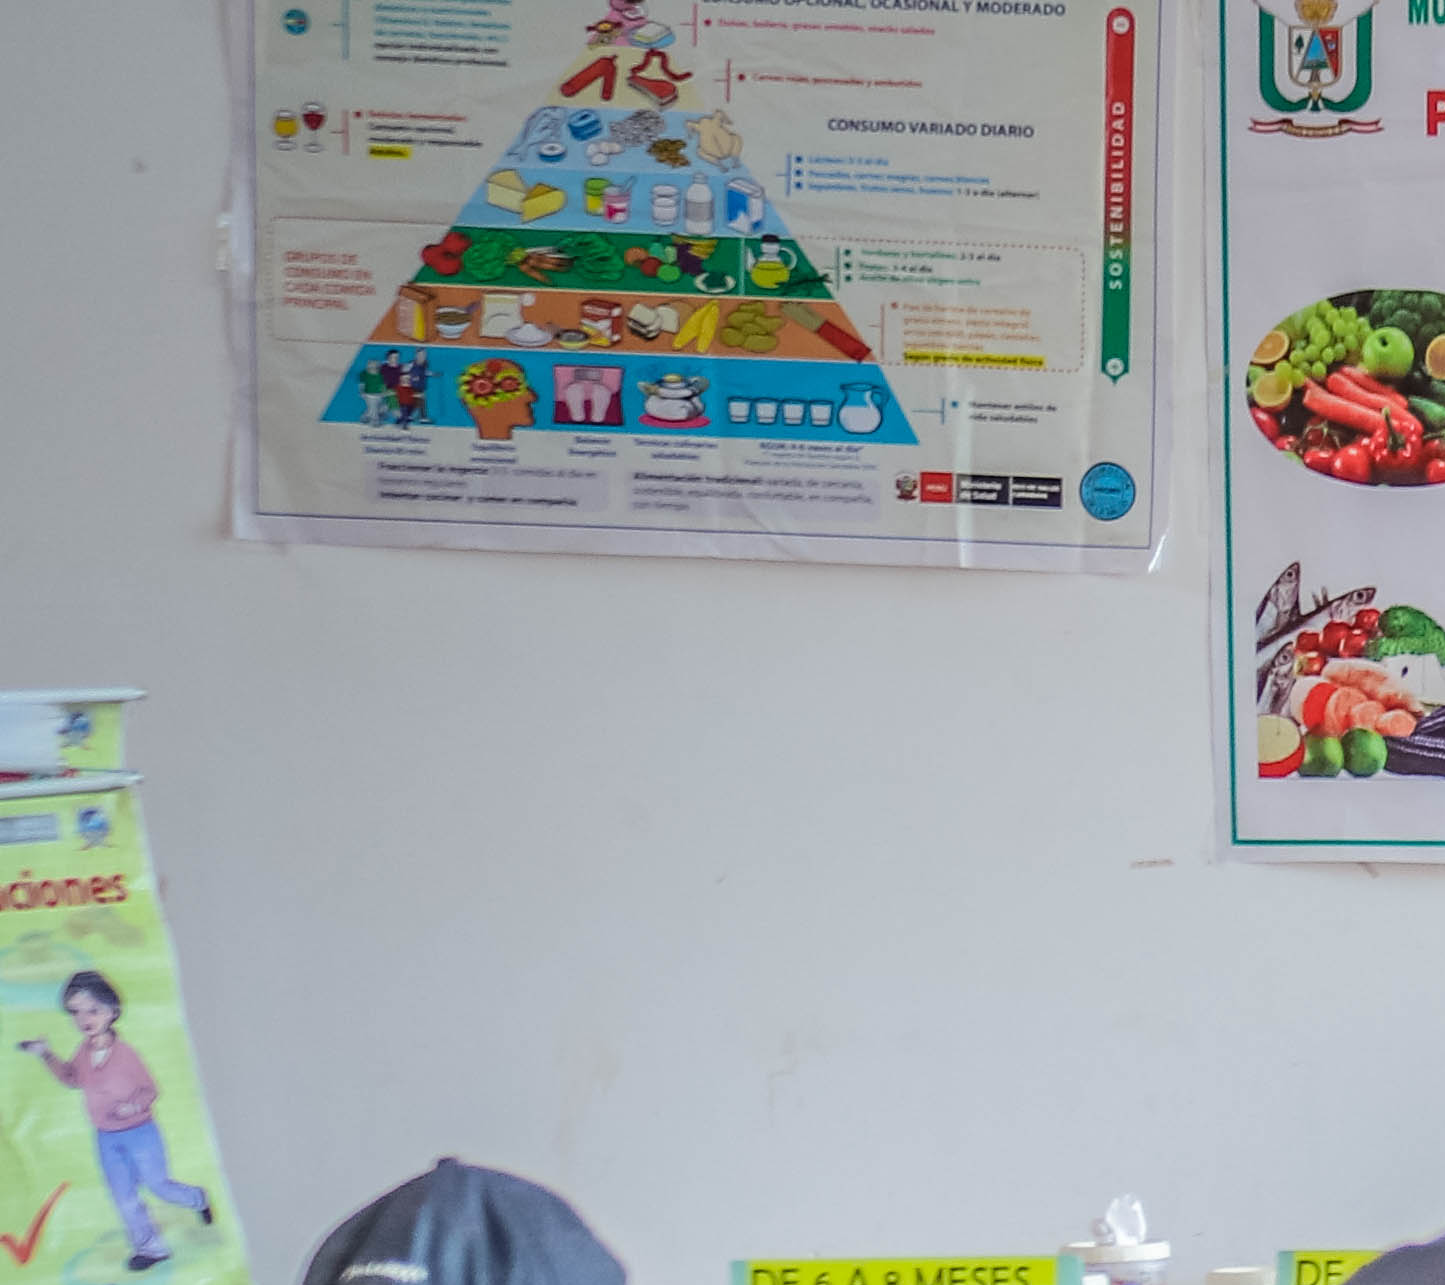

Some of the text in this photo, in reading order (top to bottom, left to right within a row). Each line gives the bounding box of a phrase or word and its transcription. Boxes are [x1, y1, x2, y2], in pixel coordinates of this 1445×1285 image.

[975, 2, 1066, 17] MODERADO
[827, 118, 1035, 139] CONSUMO VARIADO DIARIO
[1109, 101, 1126, 290] SOSTENIBILIDAD
[0, 869, 128, 914] ciones
